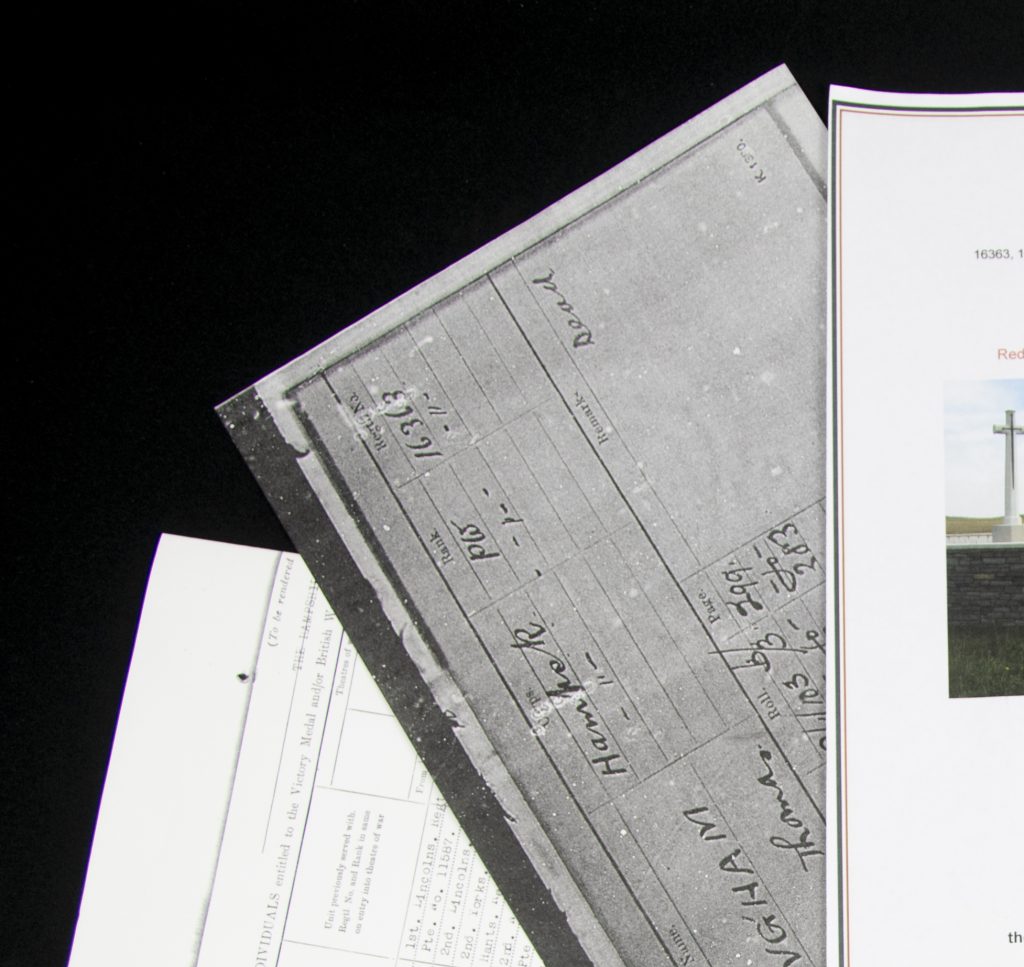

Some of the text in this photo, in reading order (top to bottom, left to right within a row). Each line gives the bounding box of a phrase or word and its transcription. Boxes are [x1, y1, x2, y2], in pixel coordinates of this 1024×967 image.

[974, 248, 1013, 262] 16363,
[531, 268, 596, 349] Dead
[277, 557, 295, 604] rendered
[272, 610, 283, 622] be
[698, 588, 721, 624] Page.
[314, 629, 333, 667] British
[310, 672, 326, 708] and/or
[756, 686, 781, 721] Roll.
[299, 712, 317, 747] Medal
[289, 753, 312, 795] Victory
[286, 802, 299, 820] the
[284, 826, 295, 838] to
[274, 843, 291, 887] entitled
[323, 833, 352, 930] Unit previously served
[662, 924, 695, 967] Name.
